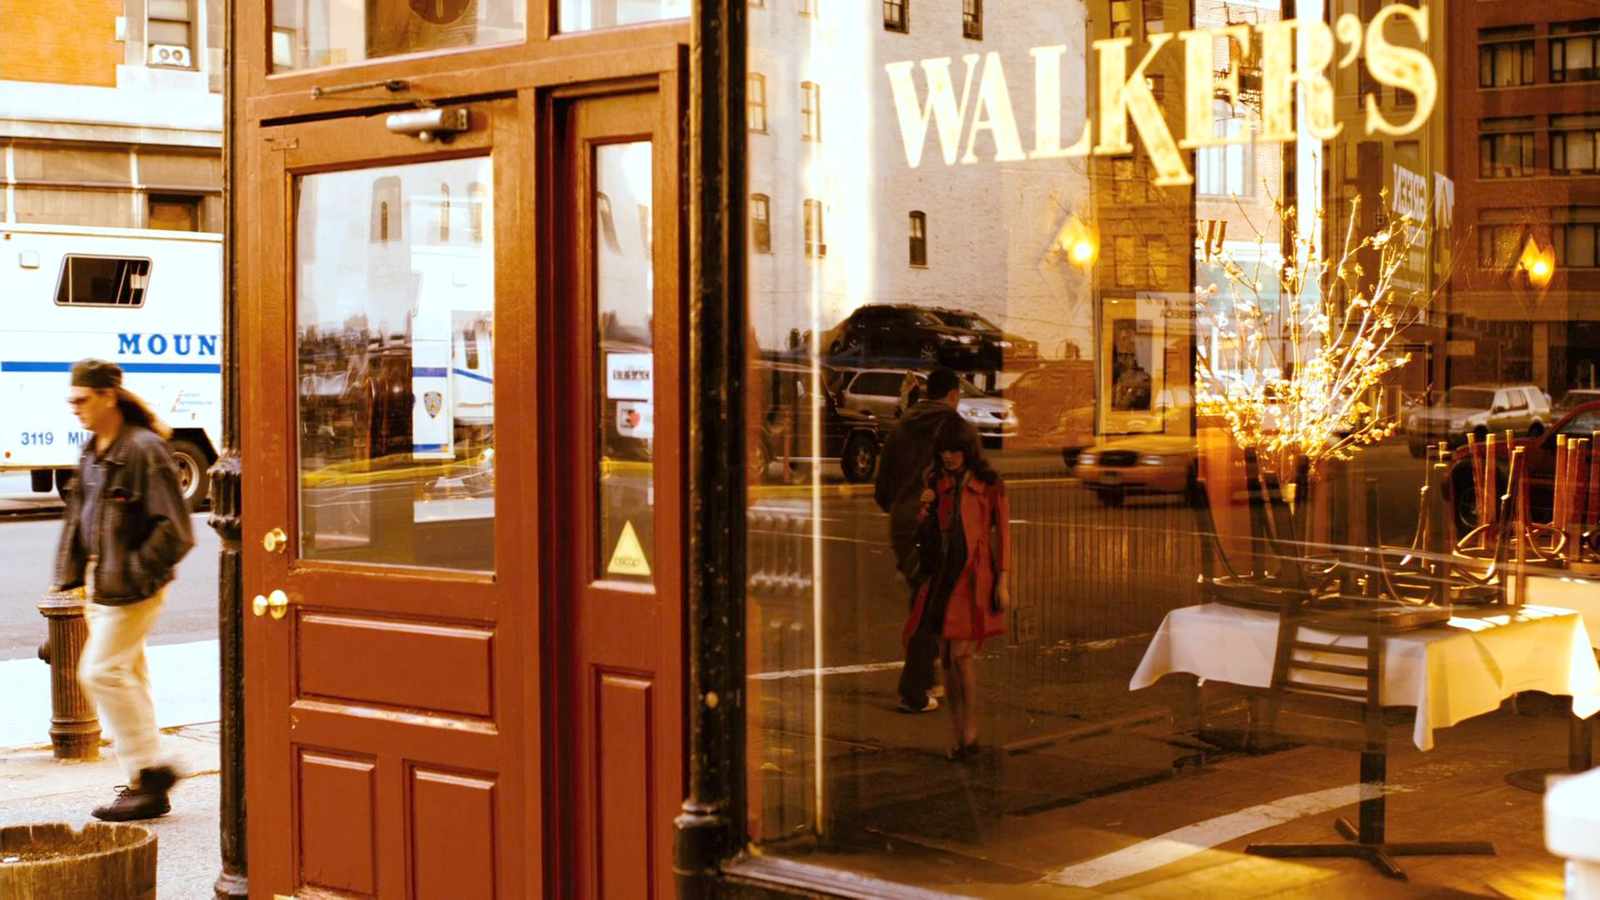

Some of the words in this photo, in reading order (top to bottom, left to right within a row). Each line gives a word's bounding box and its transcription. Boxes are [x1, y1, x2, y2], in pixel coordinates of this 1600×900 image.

[885, 4, 1437, 187] WALKER'S
[118, 333, 217, 355] MOUN
[21, 431, 54, 445] 3119
